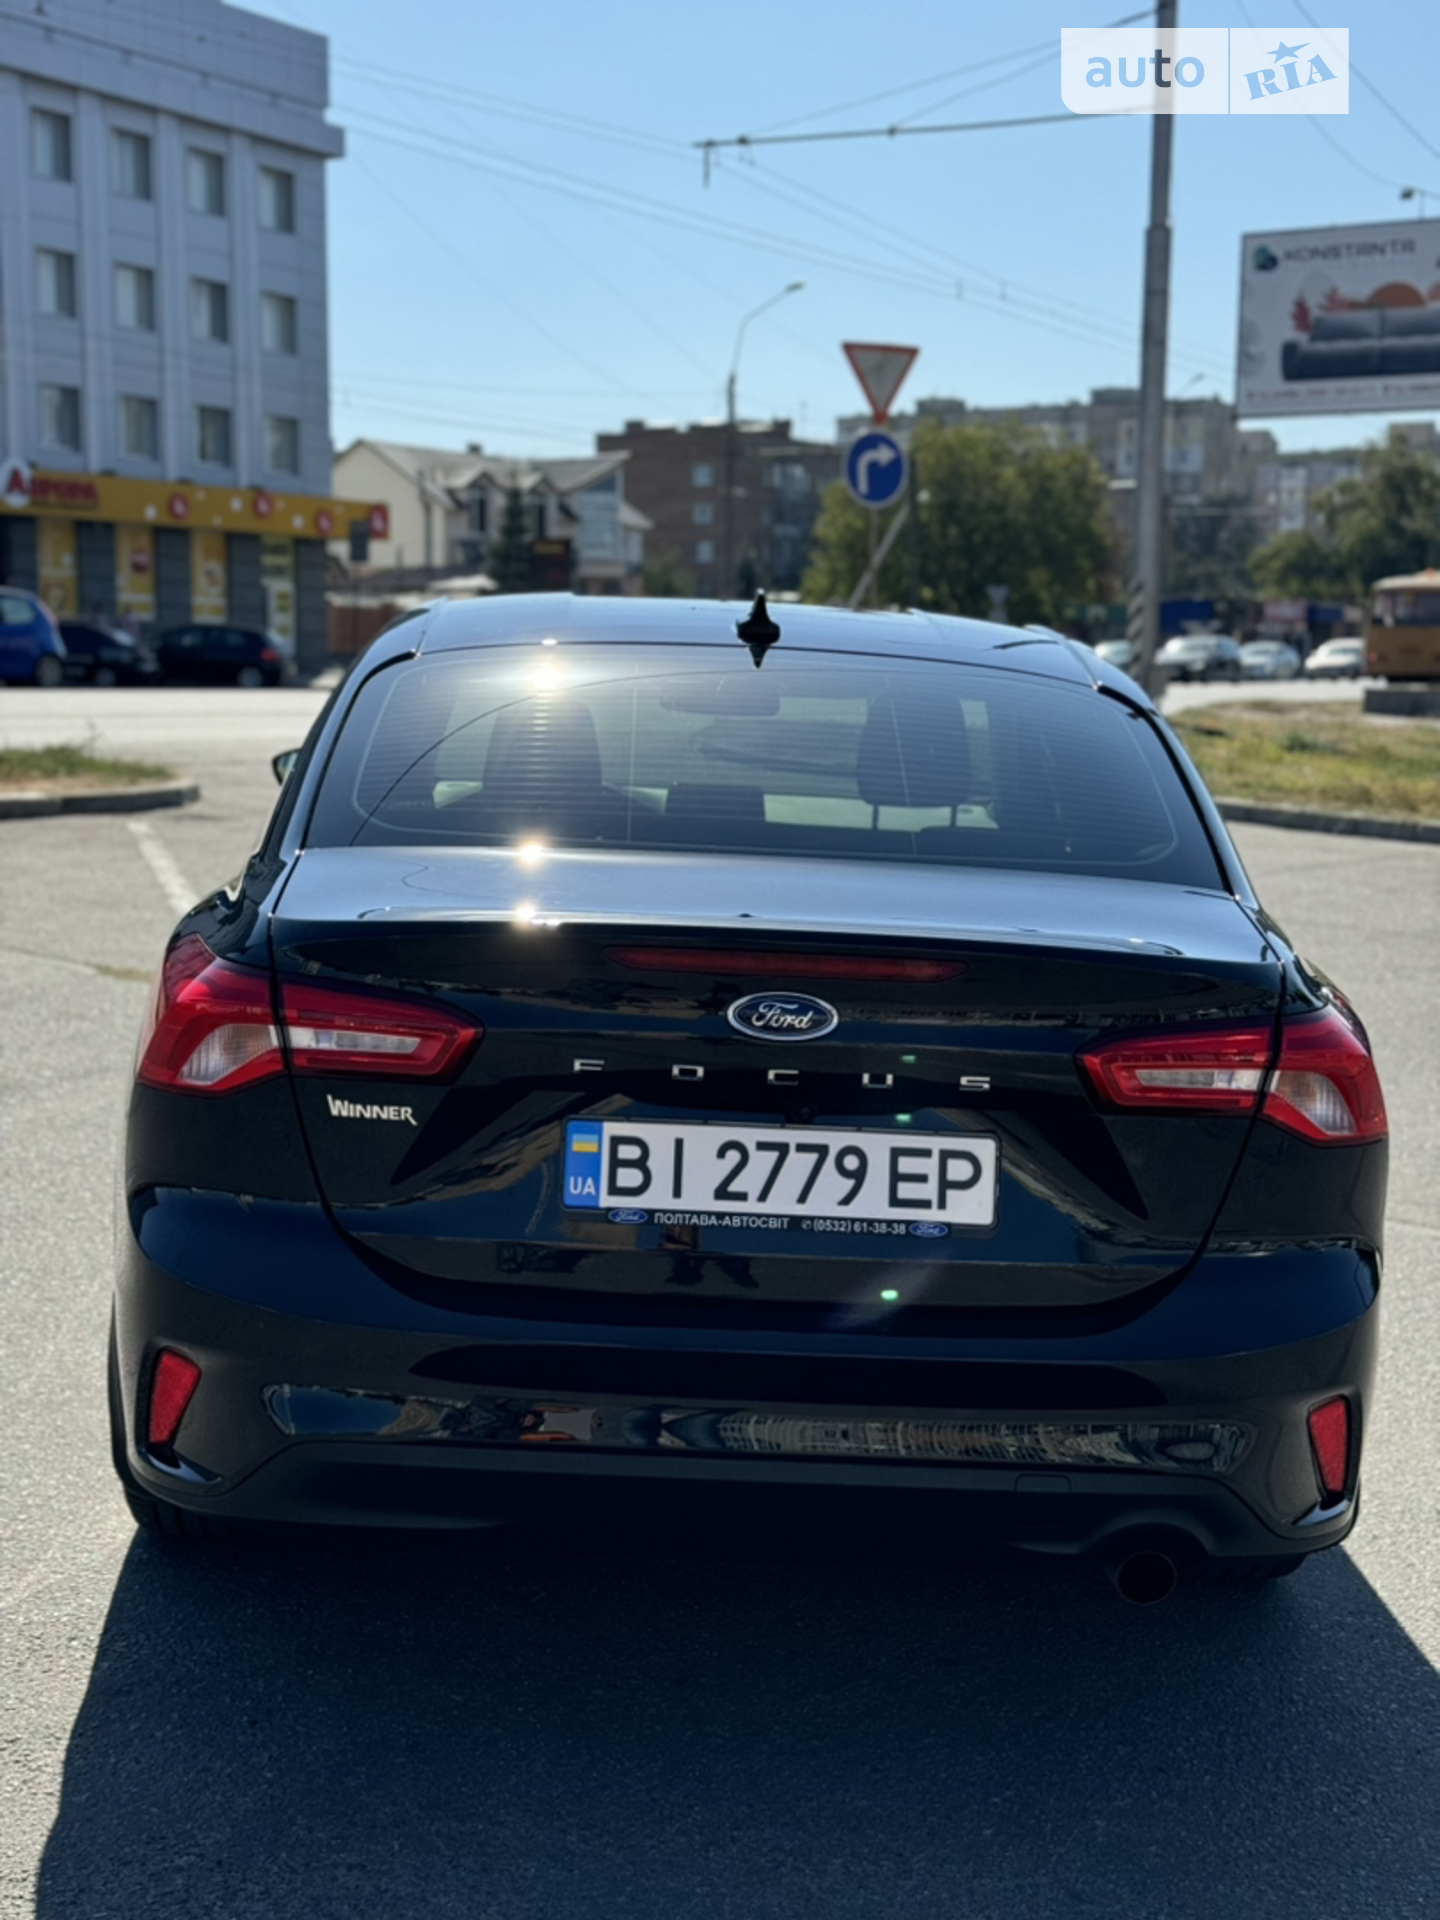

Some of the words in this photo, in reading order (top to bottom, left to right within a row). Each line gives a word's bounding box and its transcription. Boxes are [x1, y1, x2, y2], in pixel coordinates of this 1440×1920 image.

[751, 1001, 812, 1030] Ford
[573, 1058, 991, 1092] FOCUS
[569, 1176, 596, 1195] UA
[713, 1140, 869, 1206] 2779
[888, 1147, 982, 1211] EP
[653, 1212, 790, 1229] ПОЛТАВА-АВТОСВІТ
[853, 1221, 906, 1235] 61-38-38
